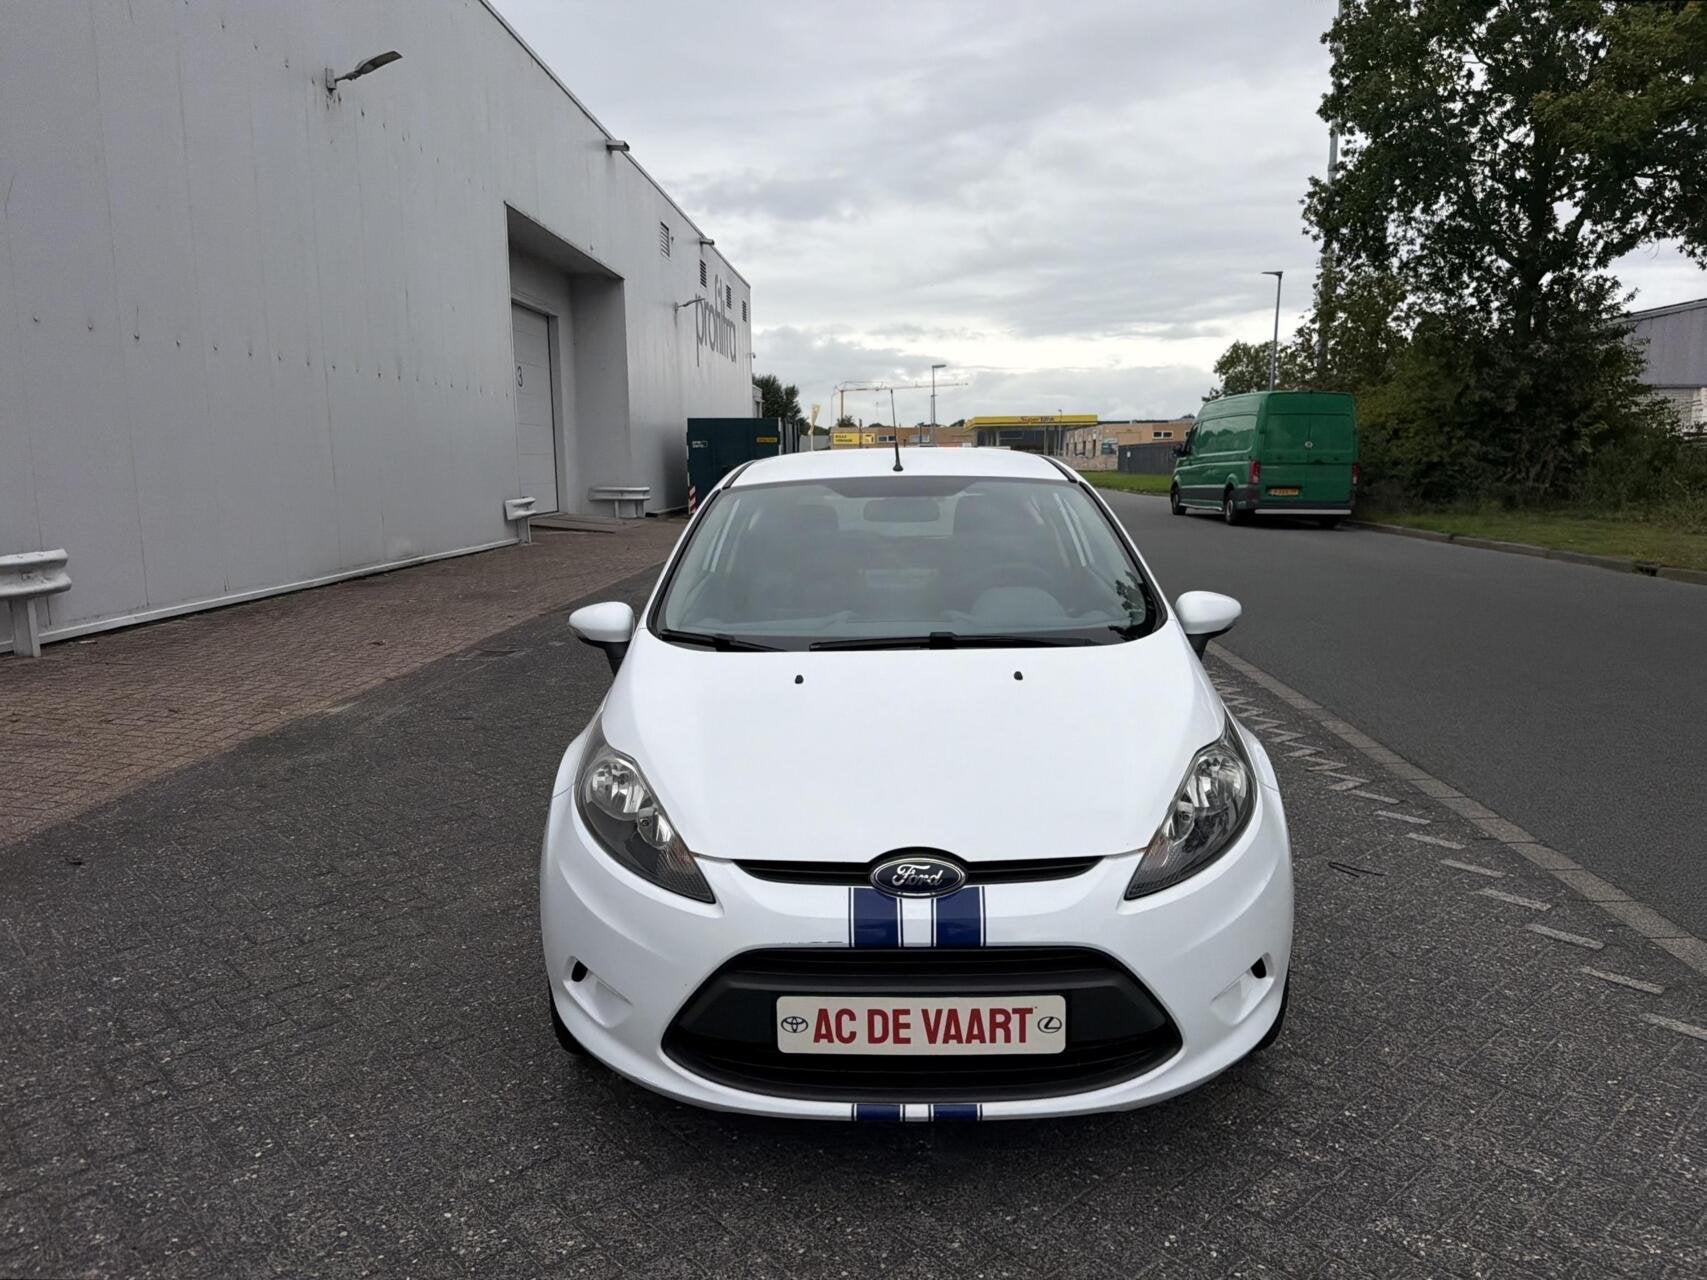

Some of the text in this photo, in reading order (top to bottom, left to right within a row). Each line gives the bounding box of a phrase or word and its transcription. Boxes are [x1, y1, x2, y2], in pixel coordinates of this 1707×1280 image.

[695, 274, 736, 367] profiltra
[517, 366, 523, 387] 3
[891, 863, 943, 886] Ford
[813, 1007, 1034, 1044] AC DE VAART
